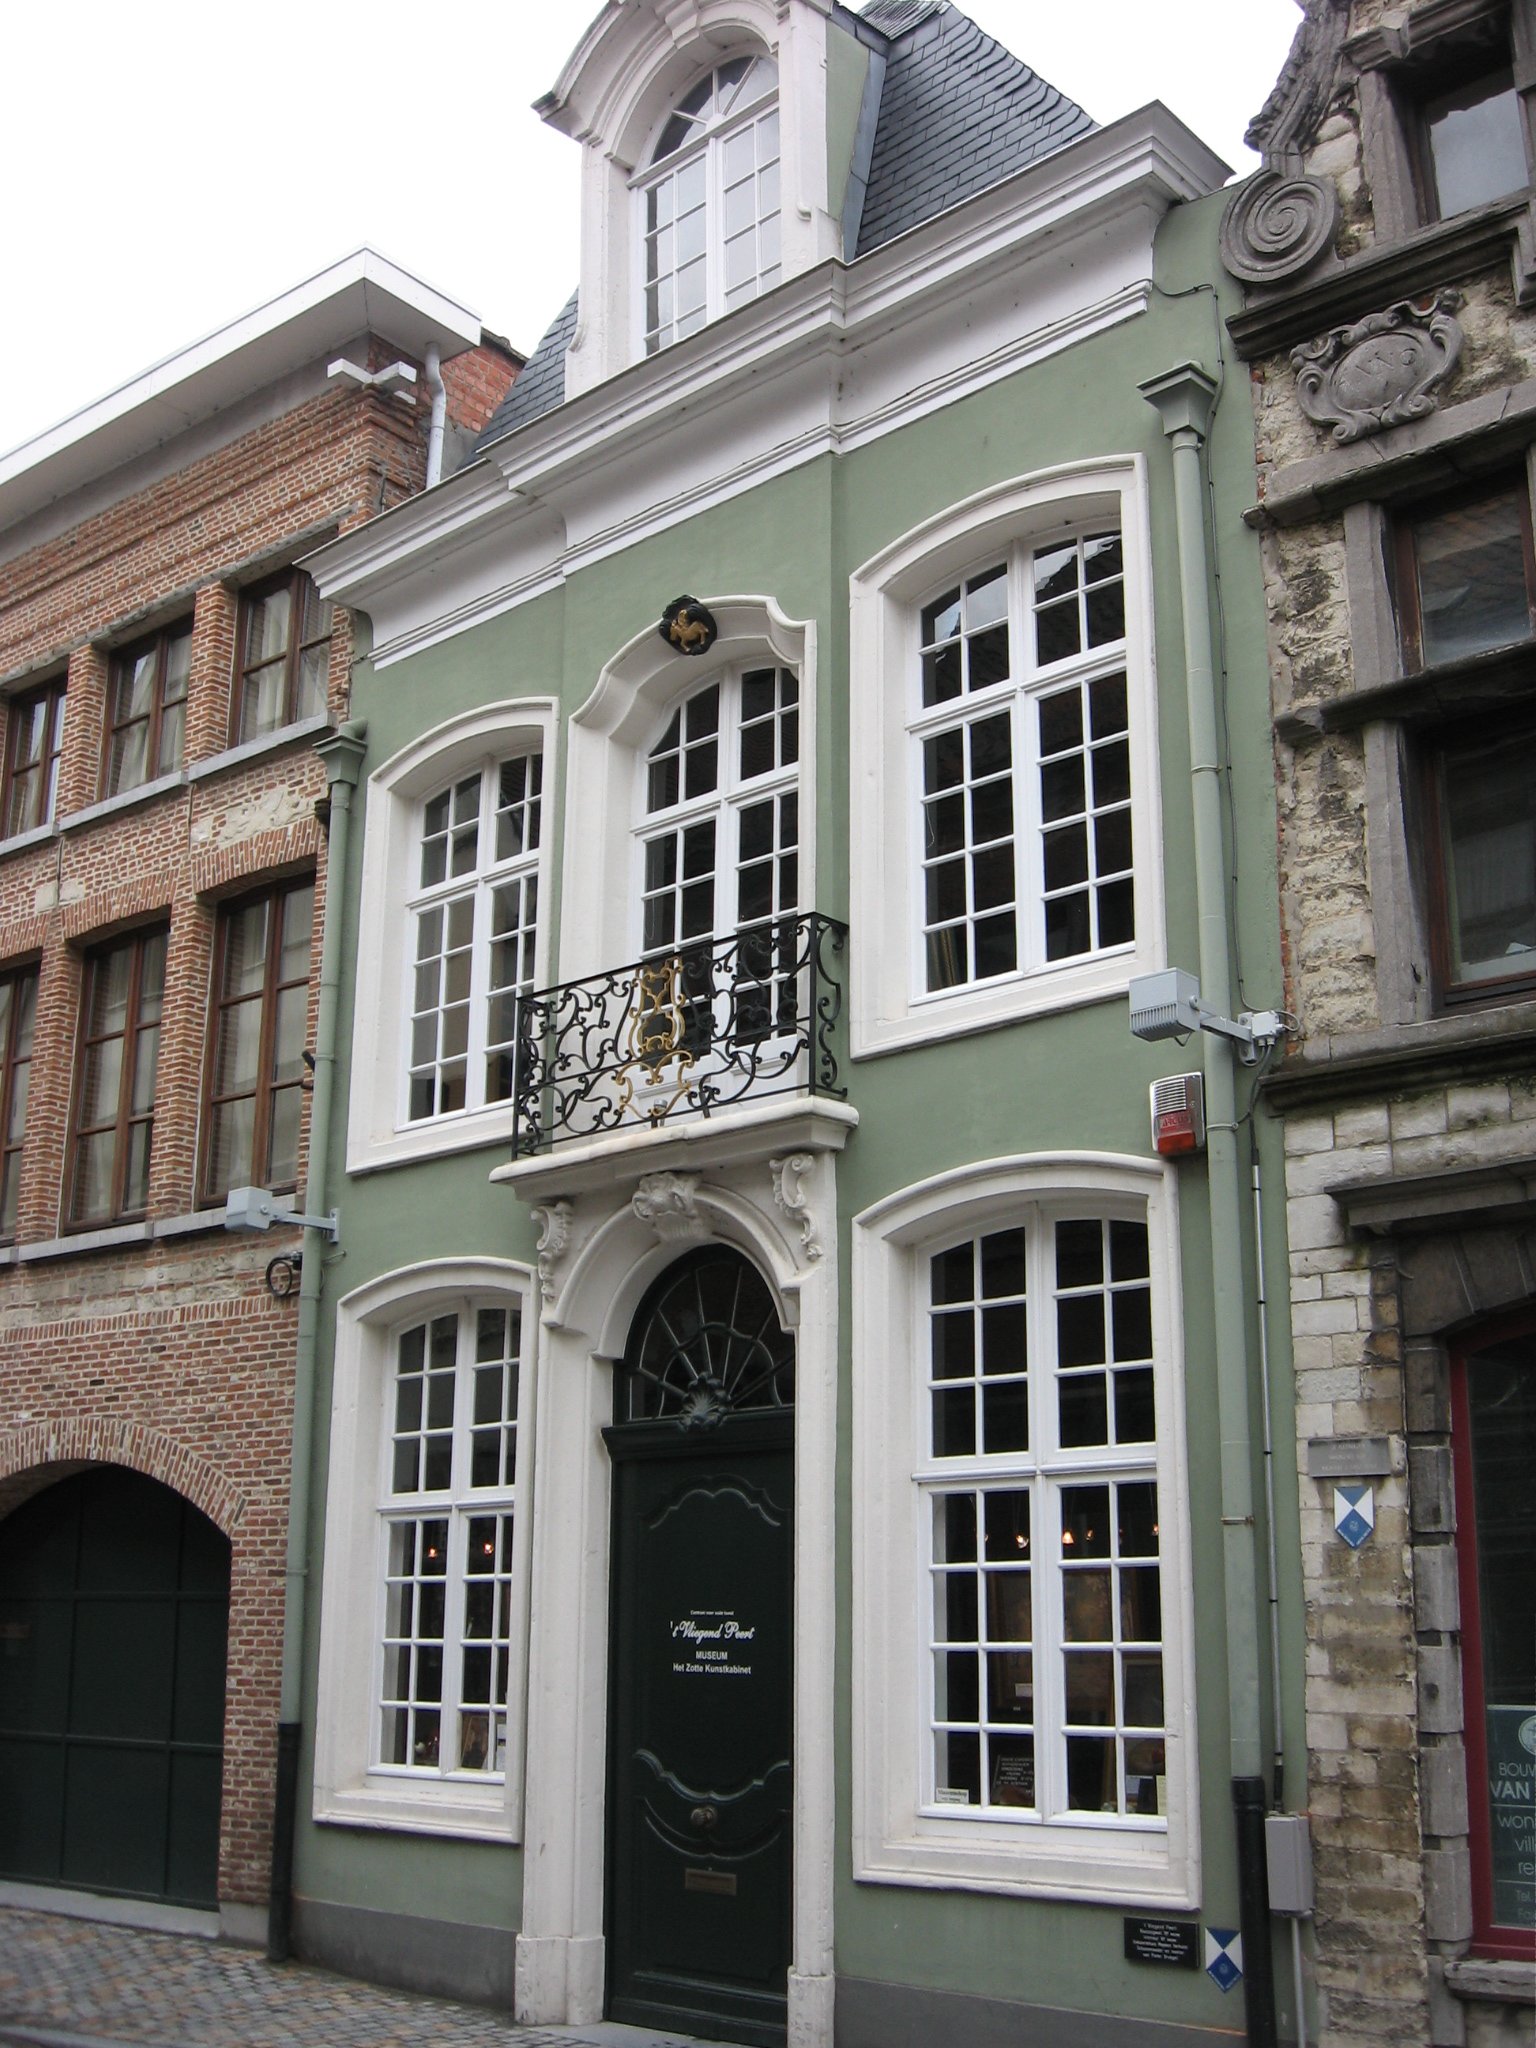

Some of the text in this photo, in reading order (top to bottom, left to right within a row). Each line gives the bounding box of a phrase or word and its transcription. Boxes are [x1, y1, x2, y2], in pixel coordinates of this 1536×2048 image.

[695, 1651, 728, 1660] MUSEUM
[673, 1663, 751, 1674] Het Zotte Kunstkabinet
[1490, 1780, 1530, 1799] VAN
